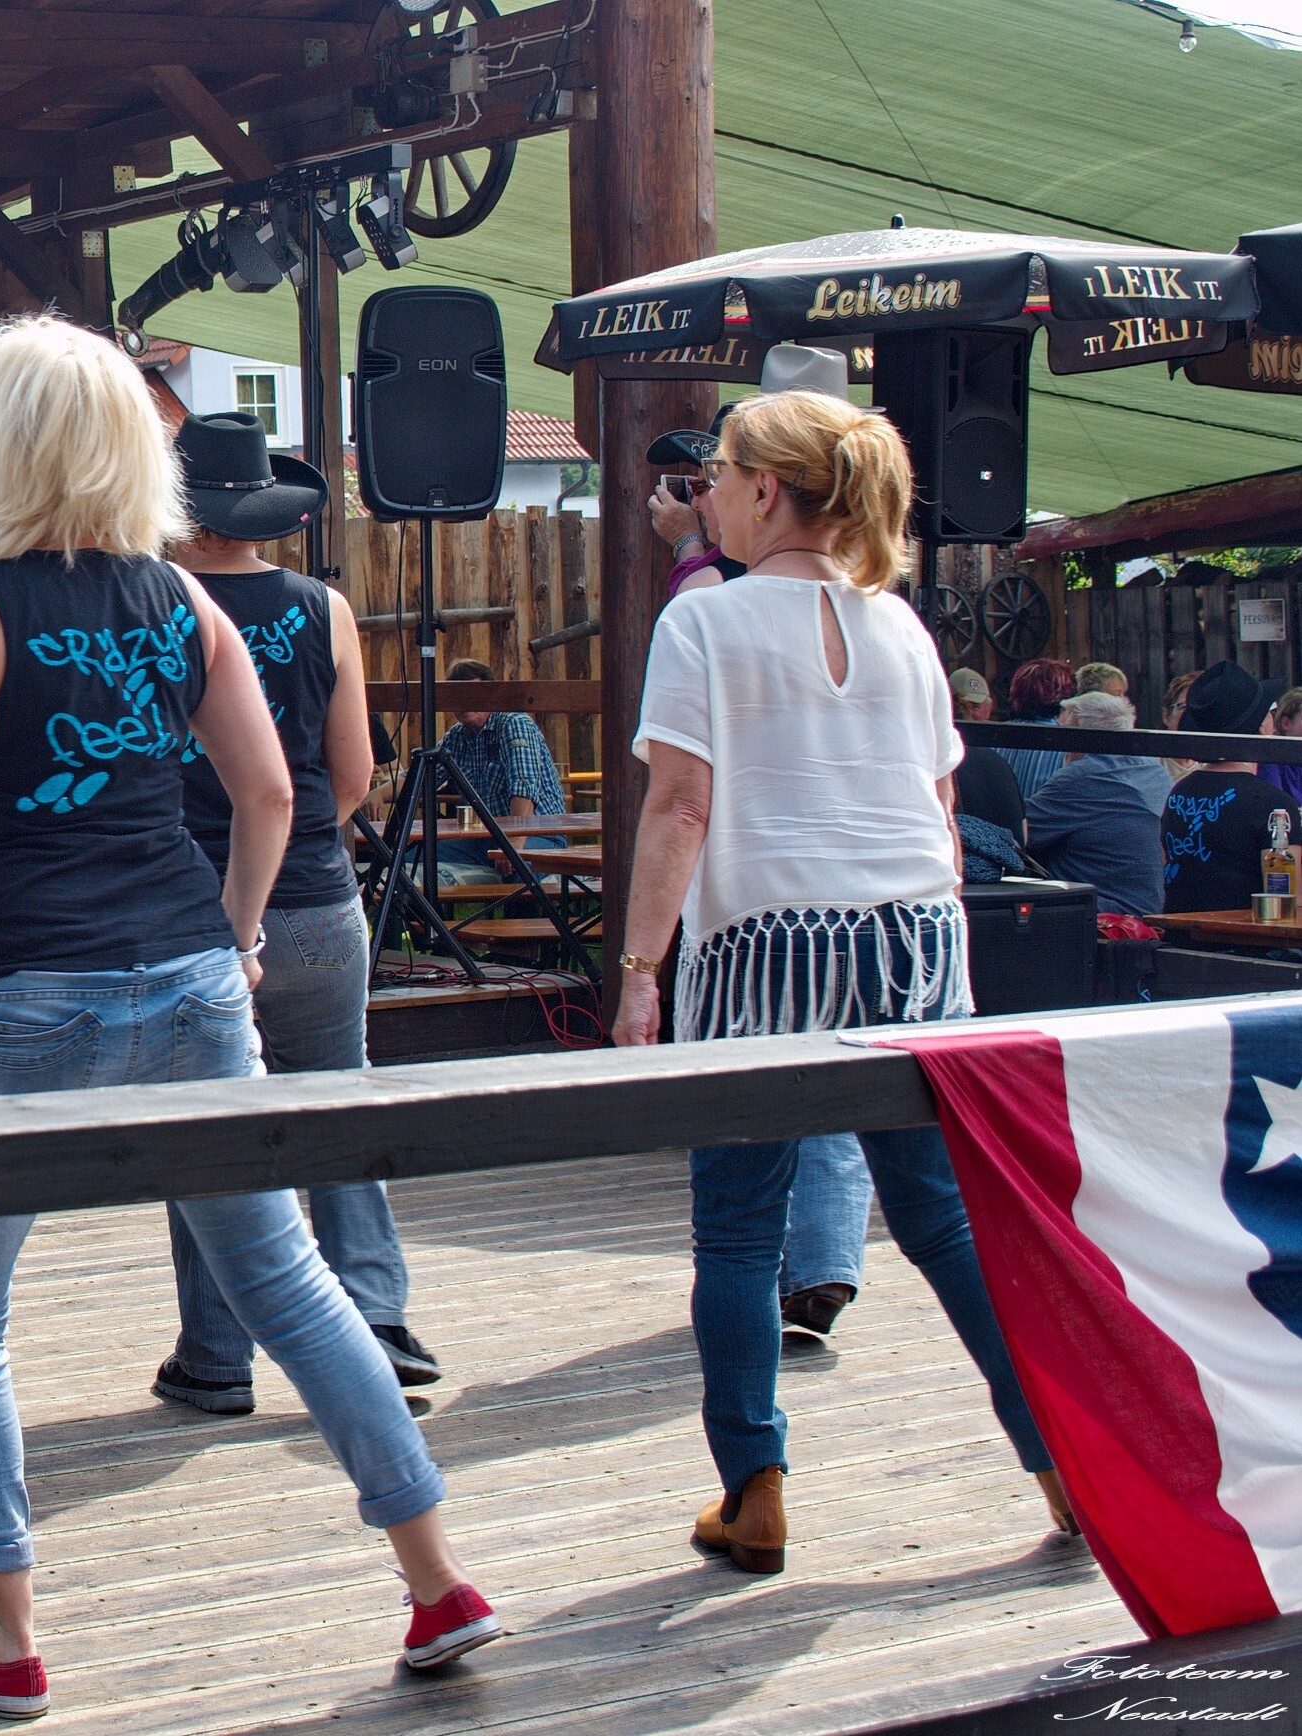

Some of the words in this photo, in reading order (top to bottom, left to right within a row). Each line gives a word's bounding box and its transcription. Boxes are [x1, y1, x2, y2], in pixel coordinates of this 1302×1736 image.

[806, 272, 961, 322] Leikeim
[1084, 277, 1097, 298] I
[1094, 266, 1191, 300] LEIK
[1193, 281, 1223, 301] IT.
[578, 320, 589, 339] I
[590, 300, 666, 338] LEIK
[671, 308, 692, 330] IT.
[418, 359, 457, 371] EON
